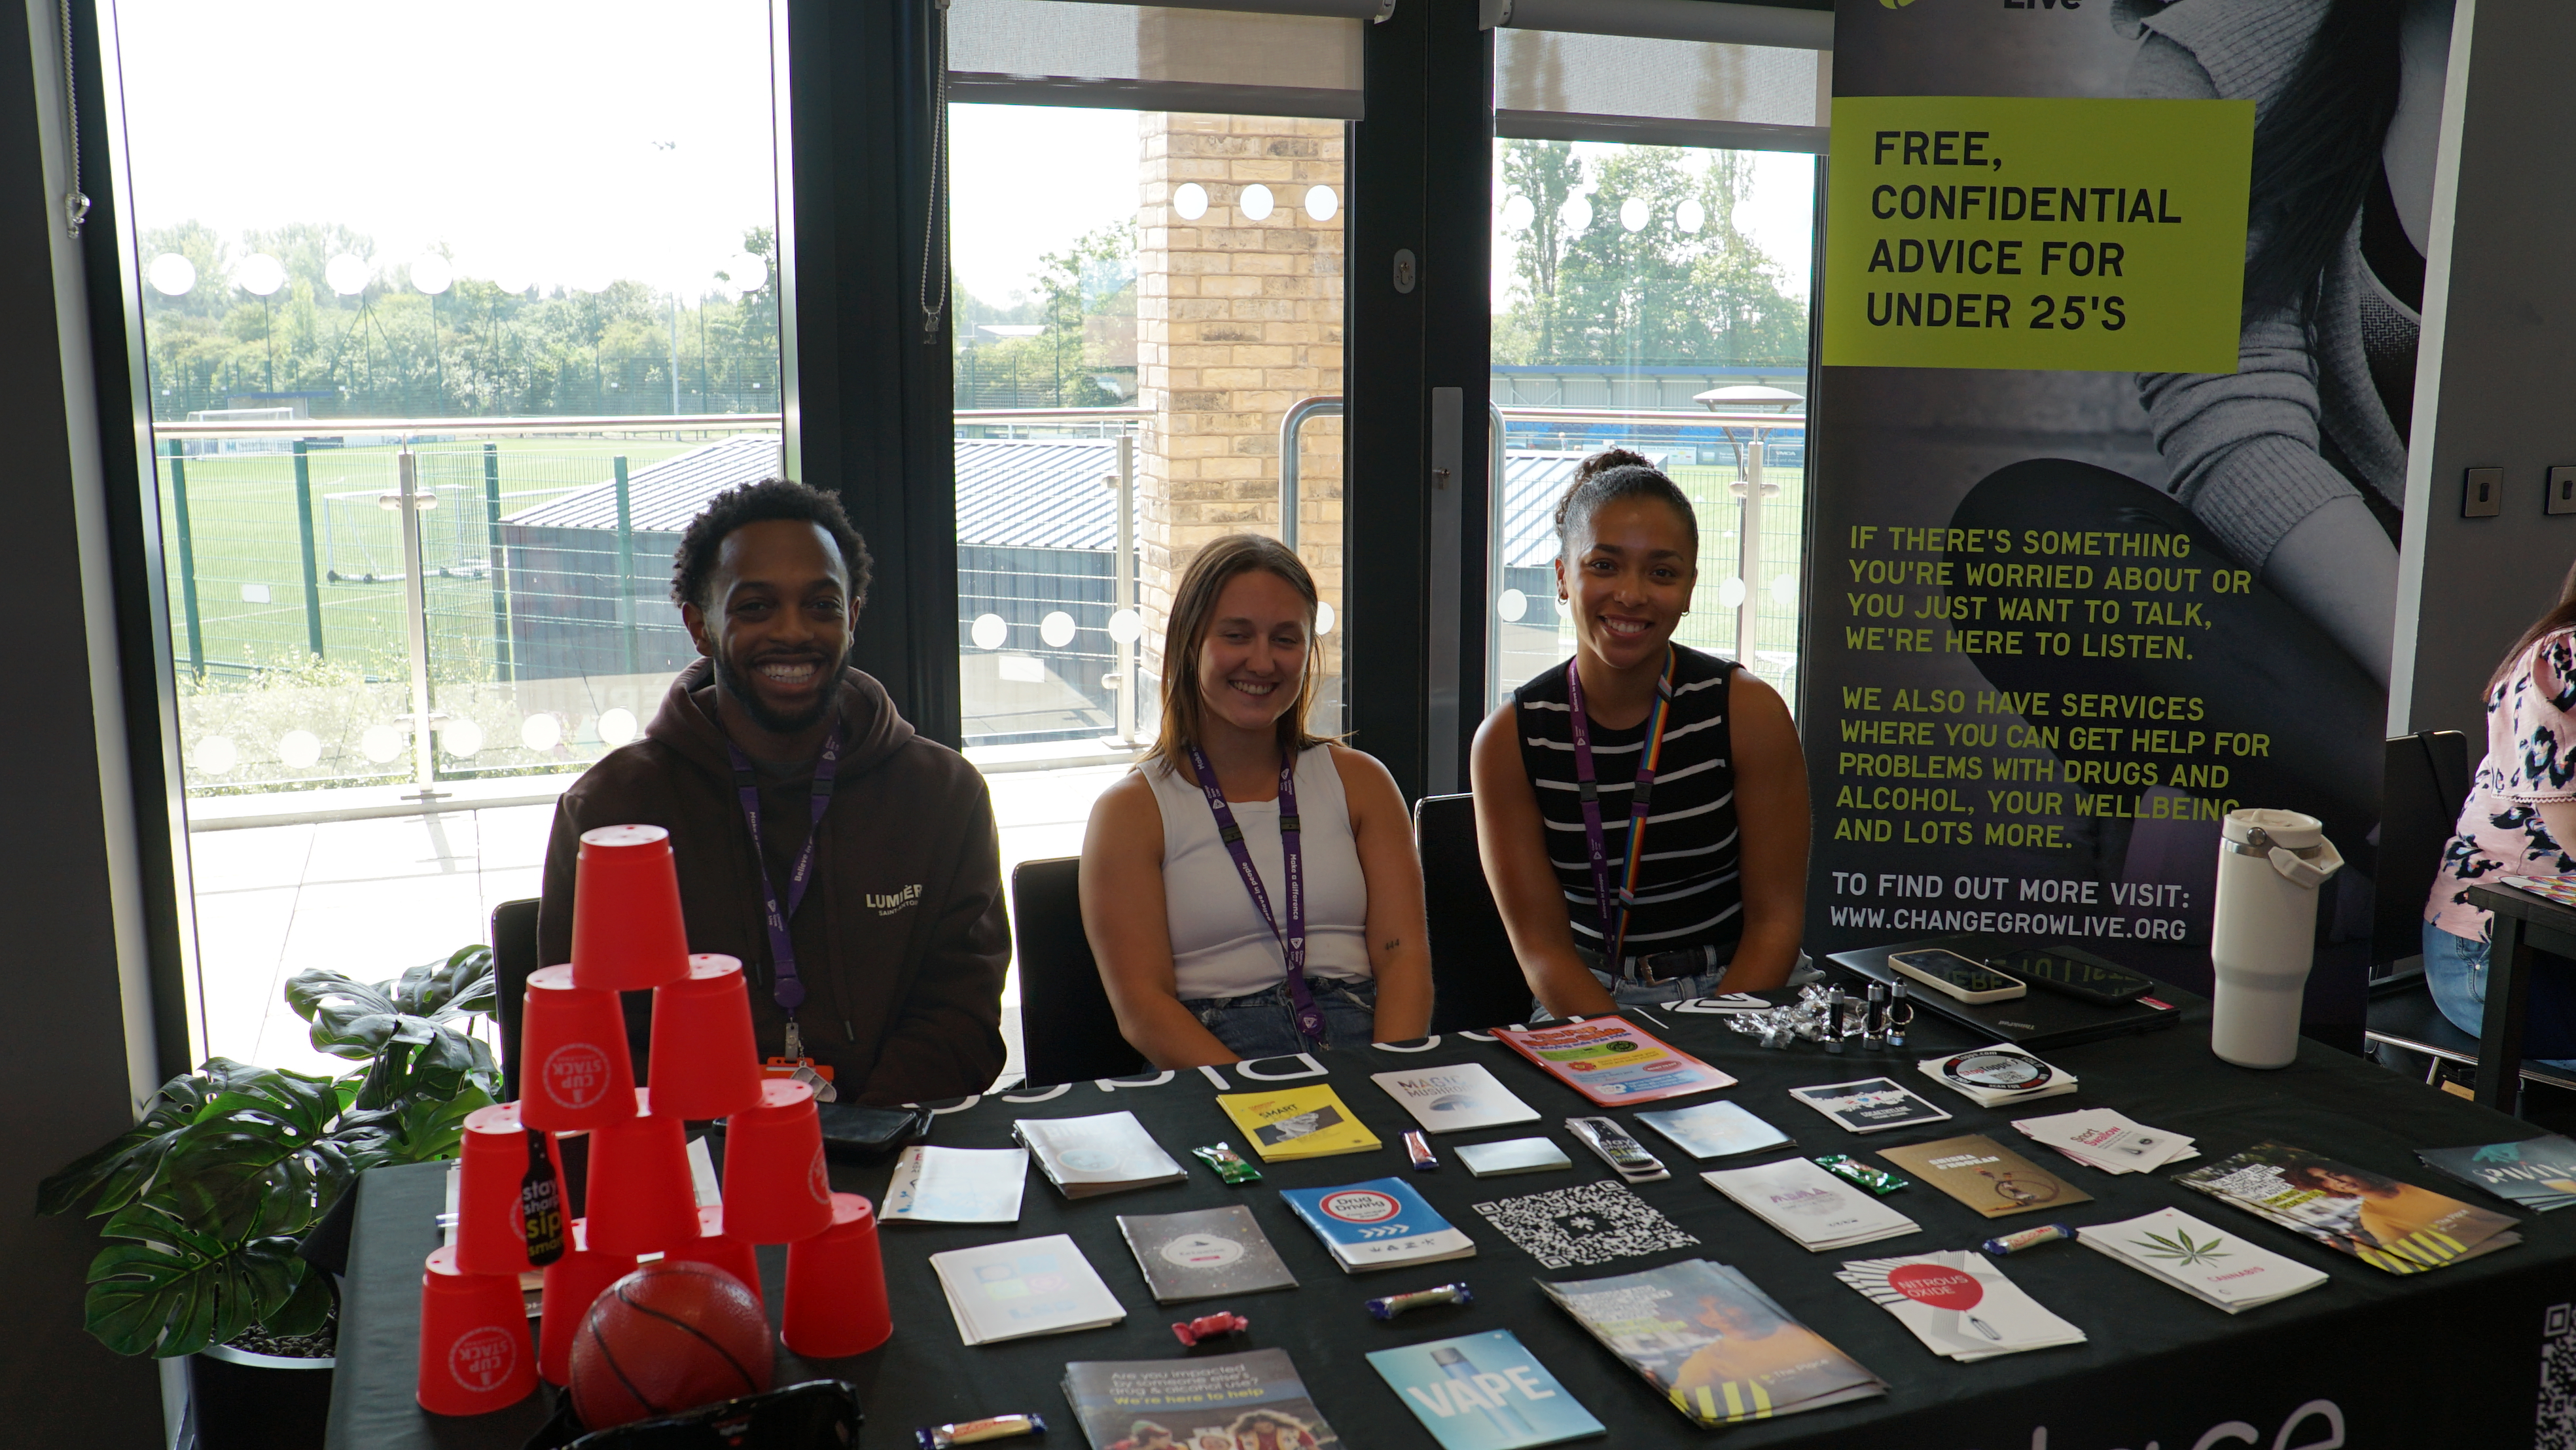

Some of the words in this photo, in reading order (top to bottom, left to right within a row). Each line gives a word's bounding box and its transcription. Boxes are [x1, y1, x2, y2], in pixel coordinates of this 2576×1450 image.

[1875, 132, 2001, 171] FREE,
[1872, 185, 2181, 223] CONFIDENTIAL
[1868, 239, 2022, 275] ADVICE
[2041, 241, 2124, 277] FOR
[1867, 292, 2011, 328] UNDER
[2030, 296, 2126, 330] 25'S
[1850, 525, 1878, 548] IF
[1889, 527, 2011, 553] THERE'S
[2022, 531, 2191, 557] SOMETHING
[1849, 559, 1954, 586] YOU'RE
[1965, 563, 2094, 589] WORRIED
[2104, 567, 2202, 592] ABOUT
[2211, 570, 2251, 593] OR
[1847, 593, 1904, 618] YOU
[1915, 595, 1987, 620] JUST
[1997, 598, 2073, 622] WANT
[2084, 600, 2119, 624] TO
[2132, 602, 2211, 630] TALK,
[1845, 626, 1933, 651] WE'RE
[1945, 629, 2022, 654] HERE
[2035, 632, 2071, 656] TO
[2083, 634, 2192, 660] LISTEN.
[1842, 686, 1882, 710] WE
[1892, 688, 1965, 713] ALSO
[1977, 691, 2050, 715] HAVE
[2061, 693, 2204, 720] SERVICES
[1840, 719, 1933, 745] WHERE
[1944, 723, 1997, 747] YOU
[2007, 724, 2059, 749] CAN
[2069, 727, 2122, 751] GET
[2132, 730, 2206, 754] HELP
[2214, 732, 2270, 757] FOR
[1839, 752, 1982, 781] PROBLEMS
[1993, 757, 2054, 782] WITH
[2064, 760, 2158, 786] DRUGS
[2169, 764, 2229, 788] AND
[1836, 786, 1975, 815] ALCOHOL,
[1987, 790, 2062, 815] YOUR
[1834, 818, 1892, 843] AND
[1904, 821, 1973, 845] LOTS
[1985, 823, 2072, 849] MORE.
[795, 854, 808, 882] Believe
[1242, 862, 1256, 885] people
[1832, 871, 1867, 896] TO
[1878, 874, 1942, 898] FIND
[1954, 876, 2009, 900] OUT
[2020, 878, 2098, 904] MORE
[2111, 882, 2189, 908] VISIT:
[1830, 906, 2186, 940] WWW.CHANGEGROWLIVE.ORG
[552, 1060, 601, 1076] STACK
[562, 1074, 594, 1088] CUP
[1397, 1075, 1466, 1091] MAGIC
[1407, 1084, 1476, 1097] MUSHROO
[1259, 1103, 1298, 1118] SMART
[2070, 1128, 2100, 1142] Snort
[1334, 1200, 1386, 1211] Driving
[1336, 1196, 1372, 1205] Drug
[526, 1211, 561, 1239] sip
[528, 1236, 564, 1257] smar
[1898, 1275, 1968, 1289] NITROUS
[1908, 1286, 1956, 1298] OXIDE
[459, 1341, 508, 1360] STACK
[469, 1356, 501, 1372] CUP
[1171, 1364, 1245, 1378] impacted
[1109, 1387, 1146, 1396] drug
[1166, 1383, 1222, 1393] alcohol
[1136, 1377, 1206, 1387] someone
[1406, 1365, 1556, 1418] VAPE
[1114, 1397, 1161, 1406] We're
[1166, 1395, 1203, 1404] here
[1227, 1388, 1264, 1398] help
